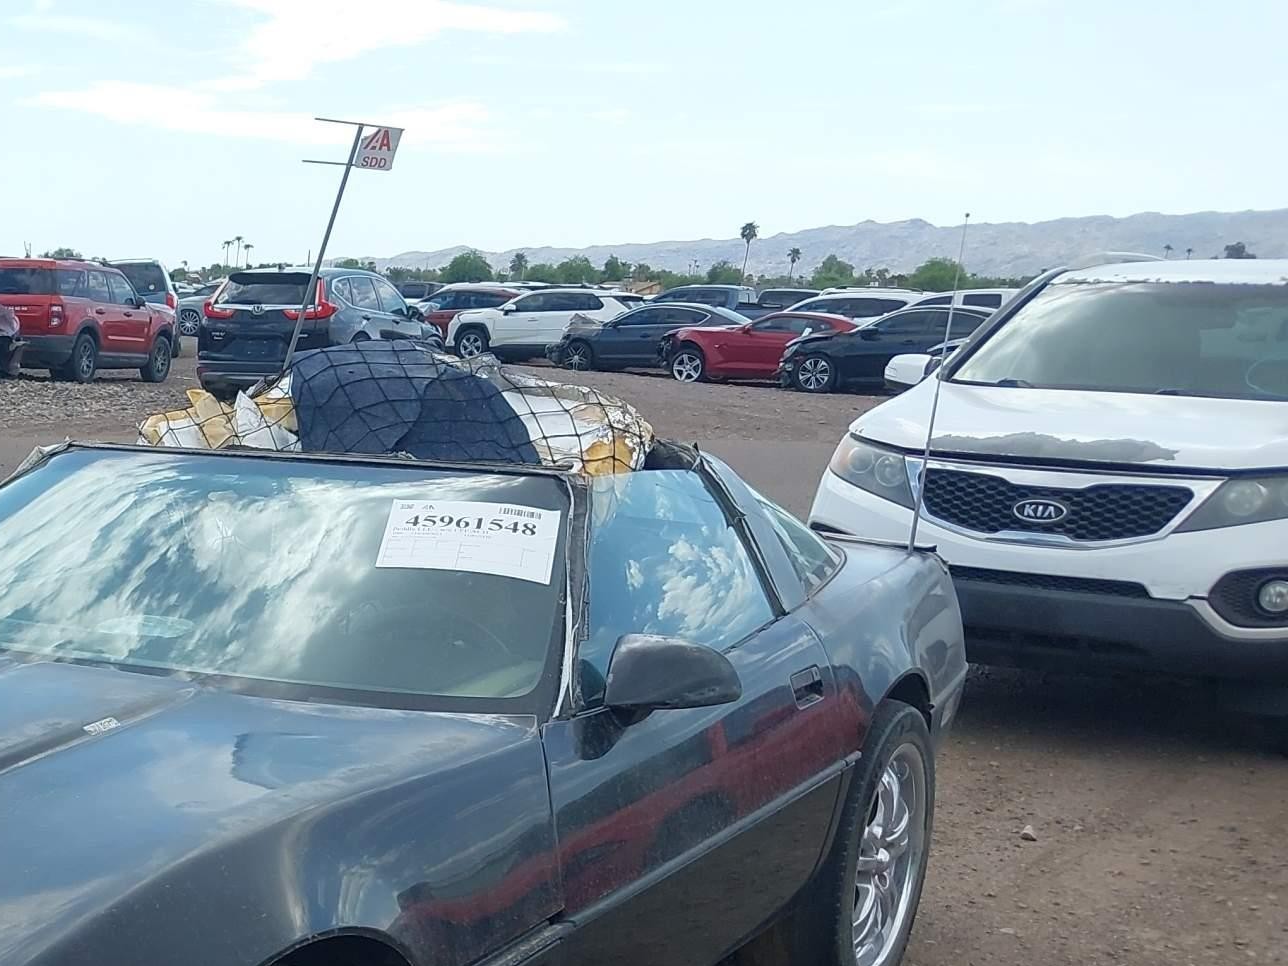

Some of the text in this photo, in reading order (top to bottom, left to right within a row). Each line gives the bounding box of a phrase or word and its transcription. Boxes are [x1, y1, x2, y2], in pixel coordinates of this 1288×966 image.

[361, 156, 387, 168] SDD
[1023, 504, 1055, 518] KIA
[405, 514, 537, 537] 45961548
